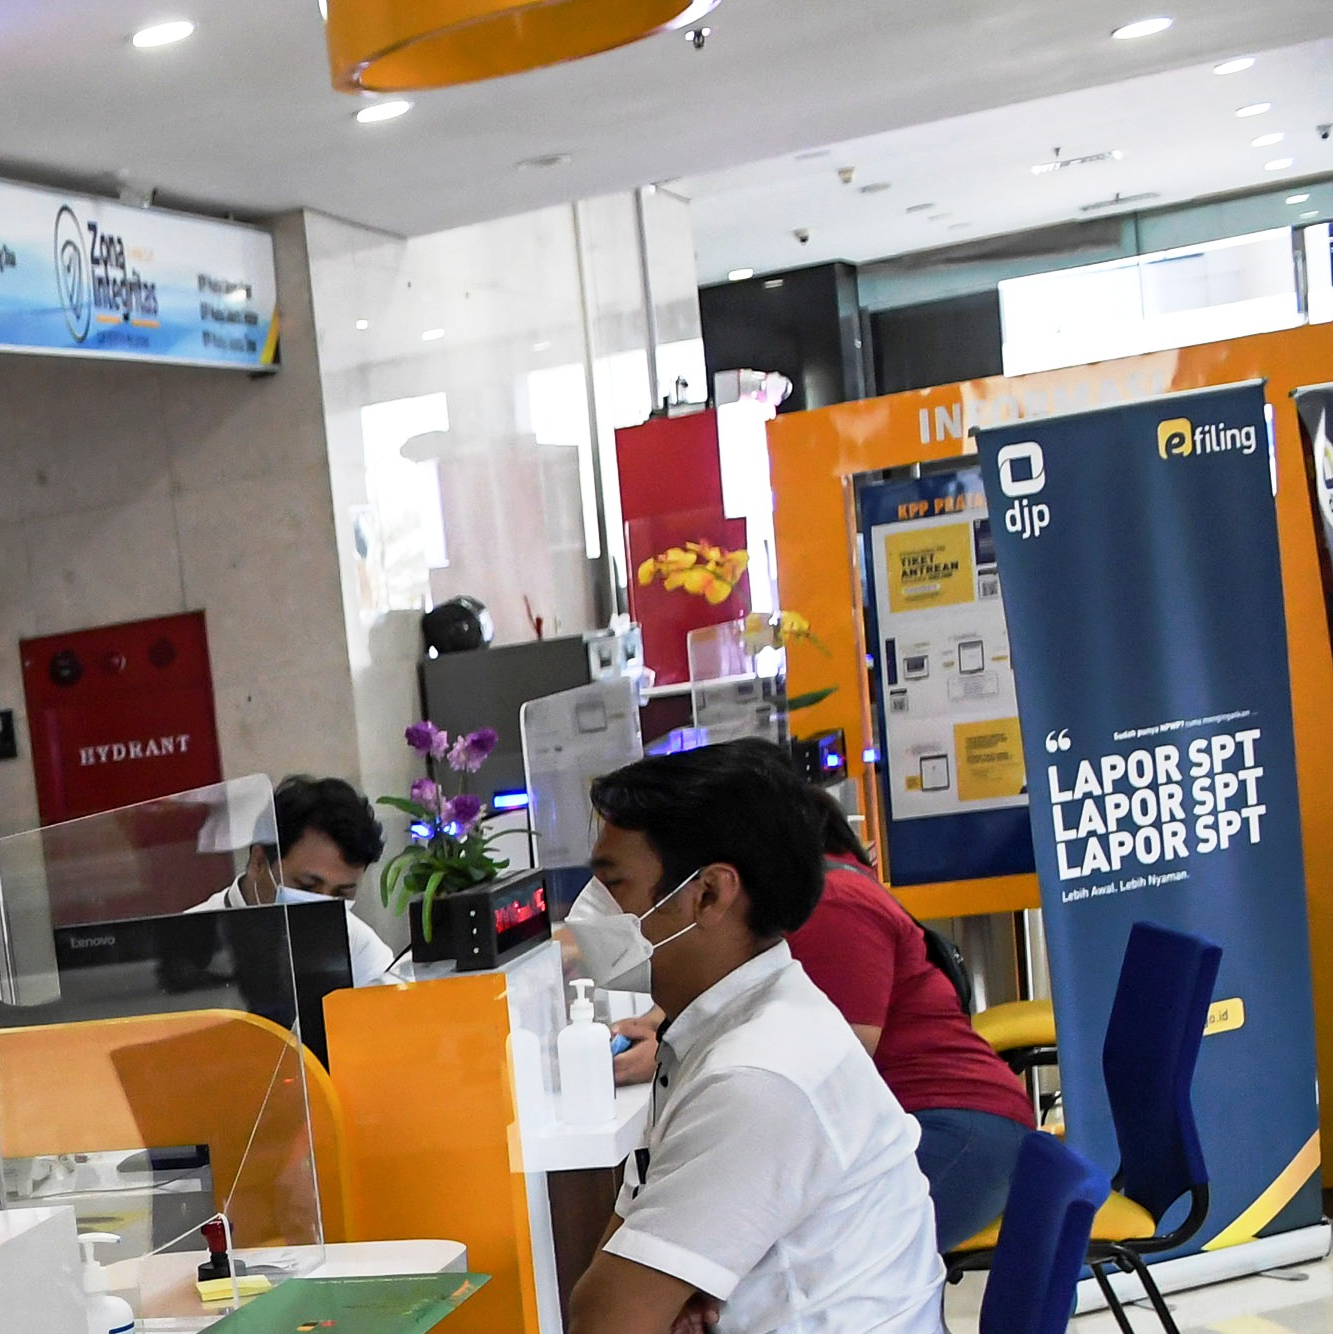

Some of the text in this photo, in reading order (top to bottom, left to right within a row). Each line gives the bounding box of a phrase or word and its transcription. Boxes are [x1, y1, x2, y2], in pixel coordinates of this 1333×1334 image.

[898, 500, 929, 521] KPP
[1005, 498, 1050, 539] djp
[900, 552, 935, 567] TIKET
[79, 734, 189, 766] HYDRANT
[1047, 744, 1183, 804] LAPOR
[1188, 728, 1261, 778] SPT
[1052, 766, 1264, 843] LAPOR SPT
[1056, 804, 1267, 881] LAPOR SPT
[1062, 869, 1190, 903] Lebih Awal. Lebih Nyaman.
[70, 936, 116, 949] Lenovo
